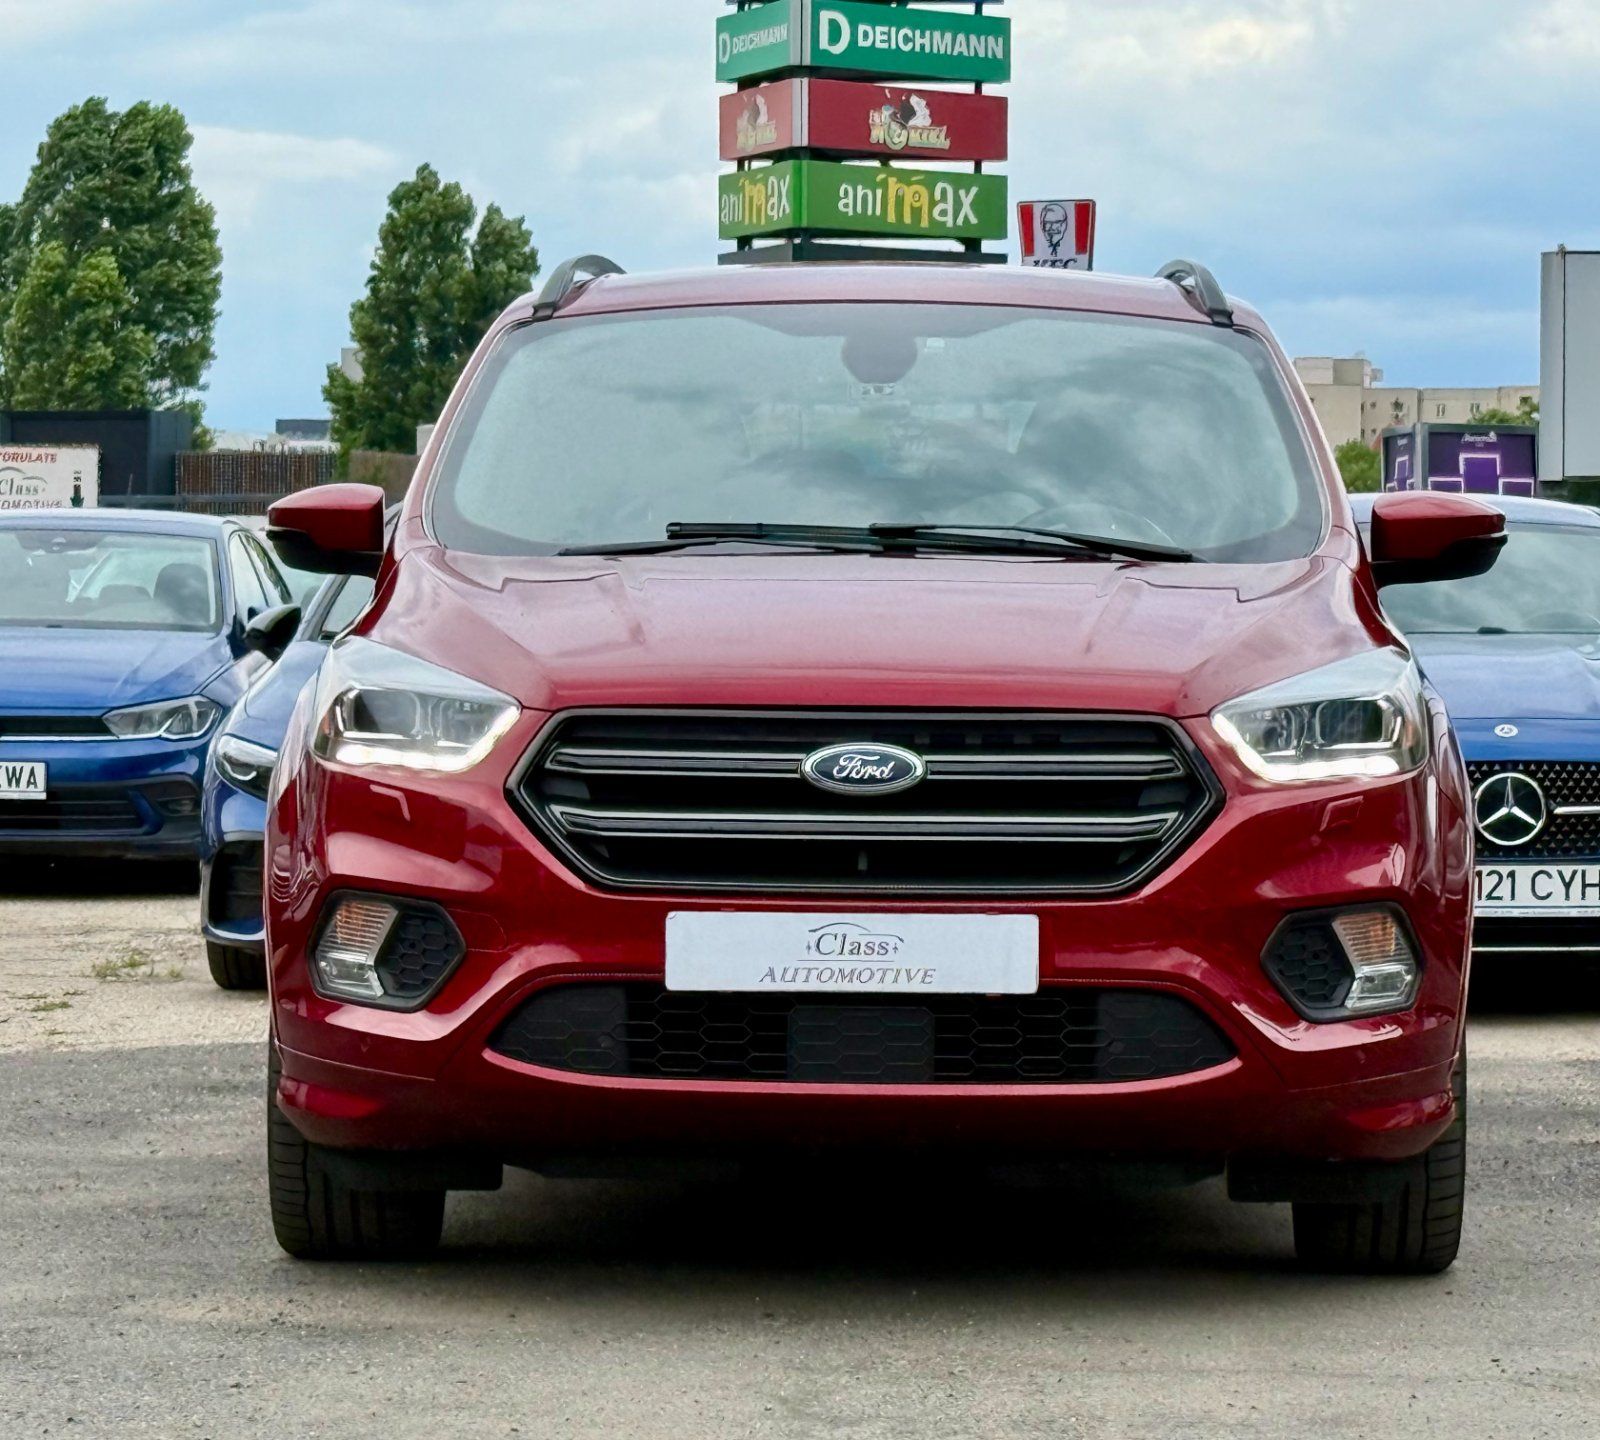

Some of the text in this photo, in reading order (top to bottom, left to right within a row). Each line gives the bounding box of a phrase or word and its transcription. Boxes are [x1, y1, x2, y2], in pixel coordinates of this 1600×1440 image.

[732, 23, 788, 55] DEICHMANN
[857, 24, 1004, 60] DEICHMANN
[720, 173, 791, 226] animax
[837, 173, 979, 228] animax
[0, 765, 38, 789] WA
[832, 753, 896, 779] Ford
[815, 932, 890, 956] Class
[758, 966, 937, 985] AUTOMOTIVE
